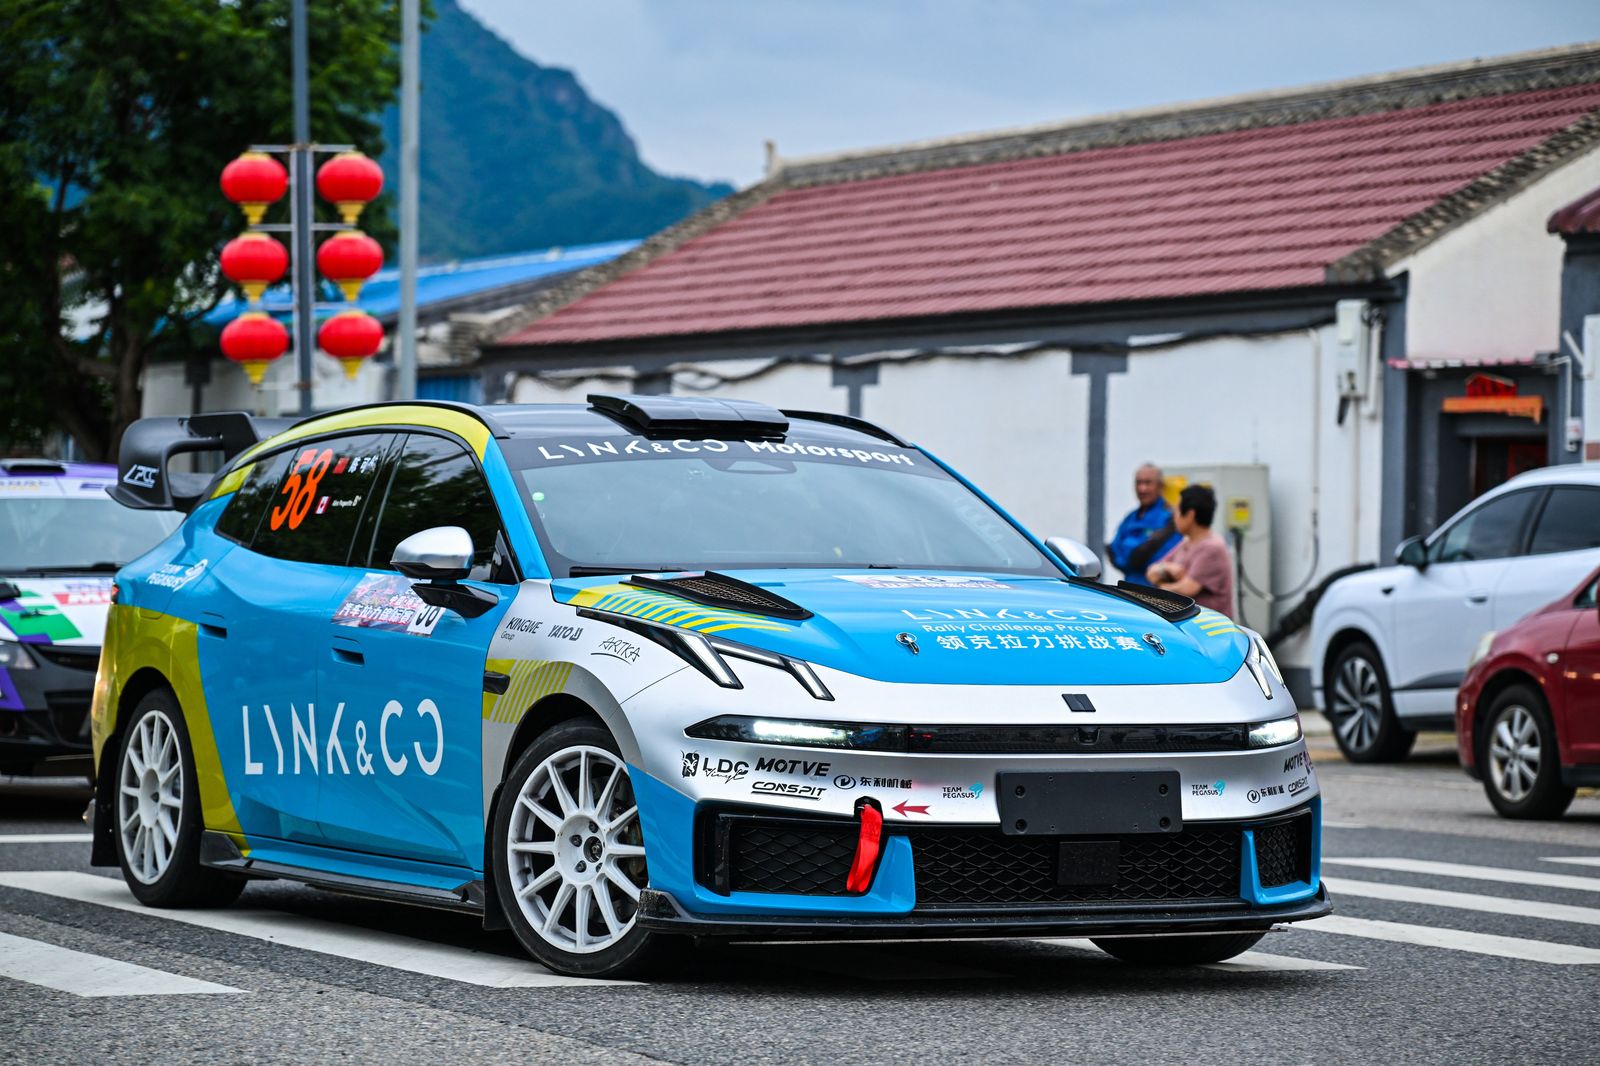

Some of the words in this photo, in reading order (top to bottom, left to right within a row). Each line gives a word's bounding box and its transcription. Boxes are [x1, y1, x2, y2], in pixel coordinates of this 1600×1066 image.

[742, 439, 915, 467] Motorsport
[270, 448, 334, 531] 58
[506, 616, 543, 634] KINGWE
[922, 624, 966, 633] Rally
[968, 623, 1053, 633] Challenge
[1057, 624, 1127, 634] Program
[936, 634, 1144, 651] 领克拉力挑战赛
[703, 757, 750, 776] LDC
[755, 757, 832, 777] MOTVE
[752, 781, 827, 796] CONSPIT
